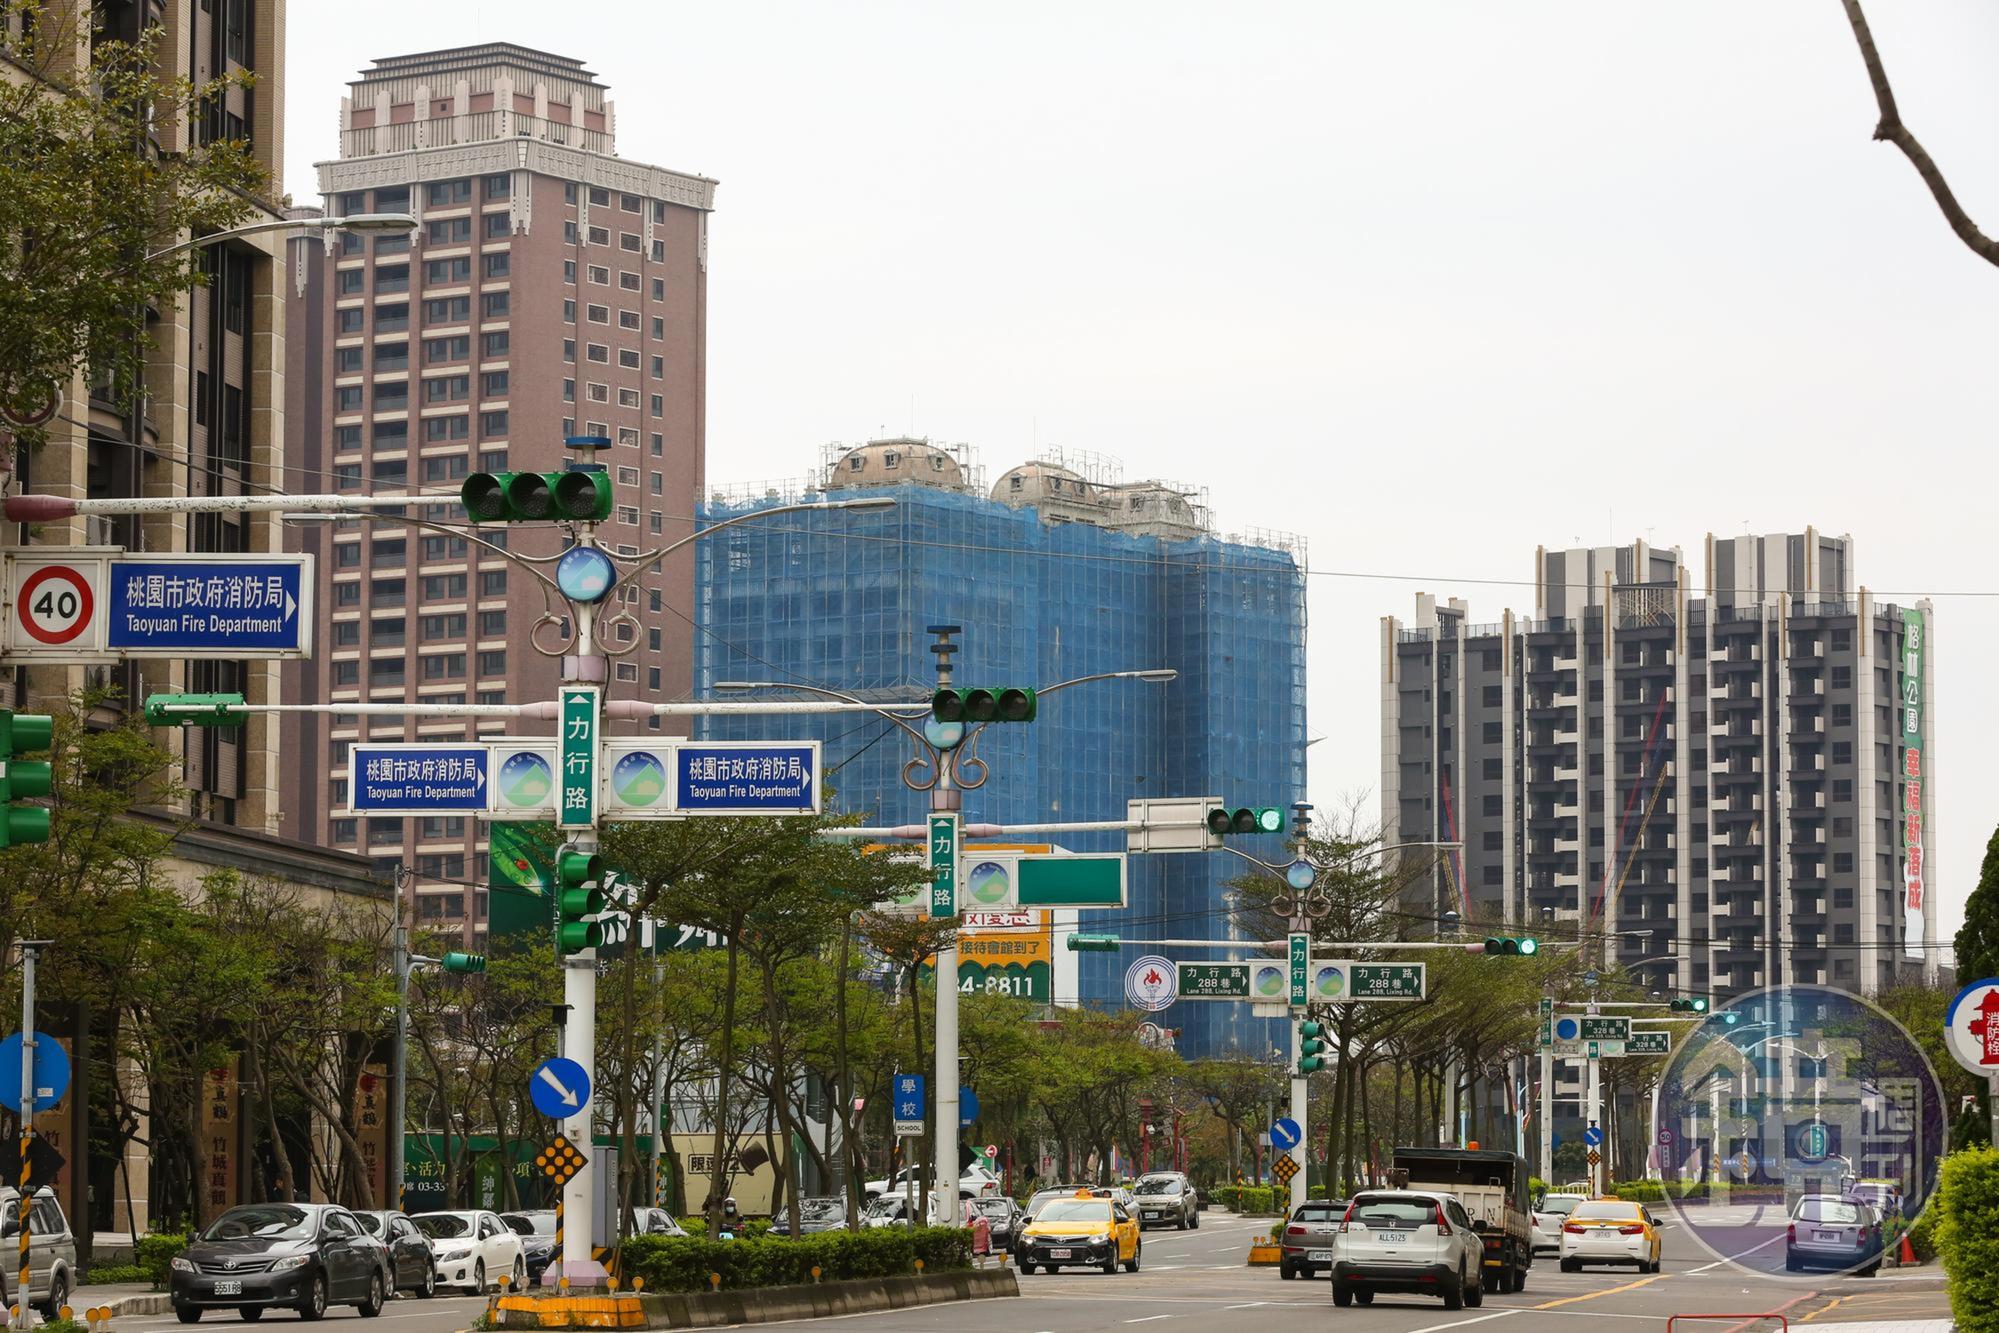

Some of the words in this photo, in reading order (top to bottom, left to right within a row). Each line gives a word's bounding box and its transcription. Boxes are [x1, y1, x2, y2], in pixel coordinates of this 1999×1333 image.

[126, 575, 284, 609] 桃園市政府消防局
[34, 592, 77, 619] 40
[126, 614, 178, 636] Taoyuan
[182, 614, 206, 633] Fire
[209, 615, 282, 636] Department
[366, 758, 476, 782] 桃園市政府消防局
[566, 715, 590, 810] 力行路
[689, 757, 801, 781] 桃園市政府消防局
[366, 786, 403, 801] Taoyuan
[405, 785, 422, 798] Fire
[425, 785, 476, 801] Department
[690, 784, 727, 801] Taoyuan
[729, 784, 747, 797] Fire
[749, 784, 801, 800] Department
[934, 836, 951, 906] 力行路
[960, 941, 1040, 955] 接待會館到了
[1187, 967, 1242, 978] 力行路
[1292, 949, 1305, 997] 力行路
[1358, 968, 1413, 978] 力行路
[957, 976, 1033, 996] 4-8811
[902, 1079, 917, 1117] 學校
